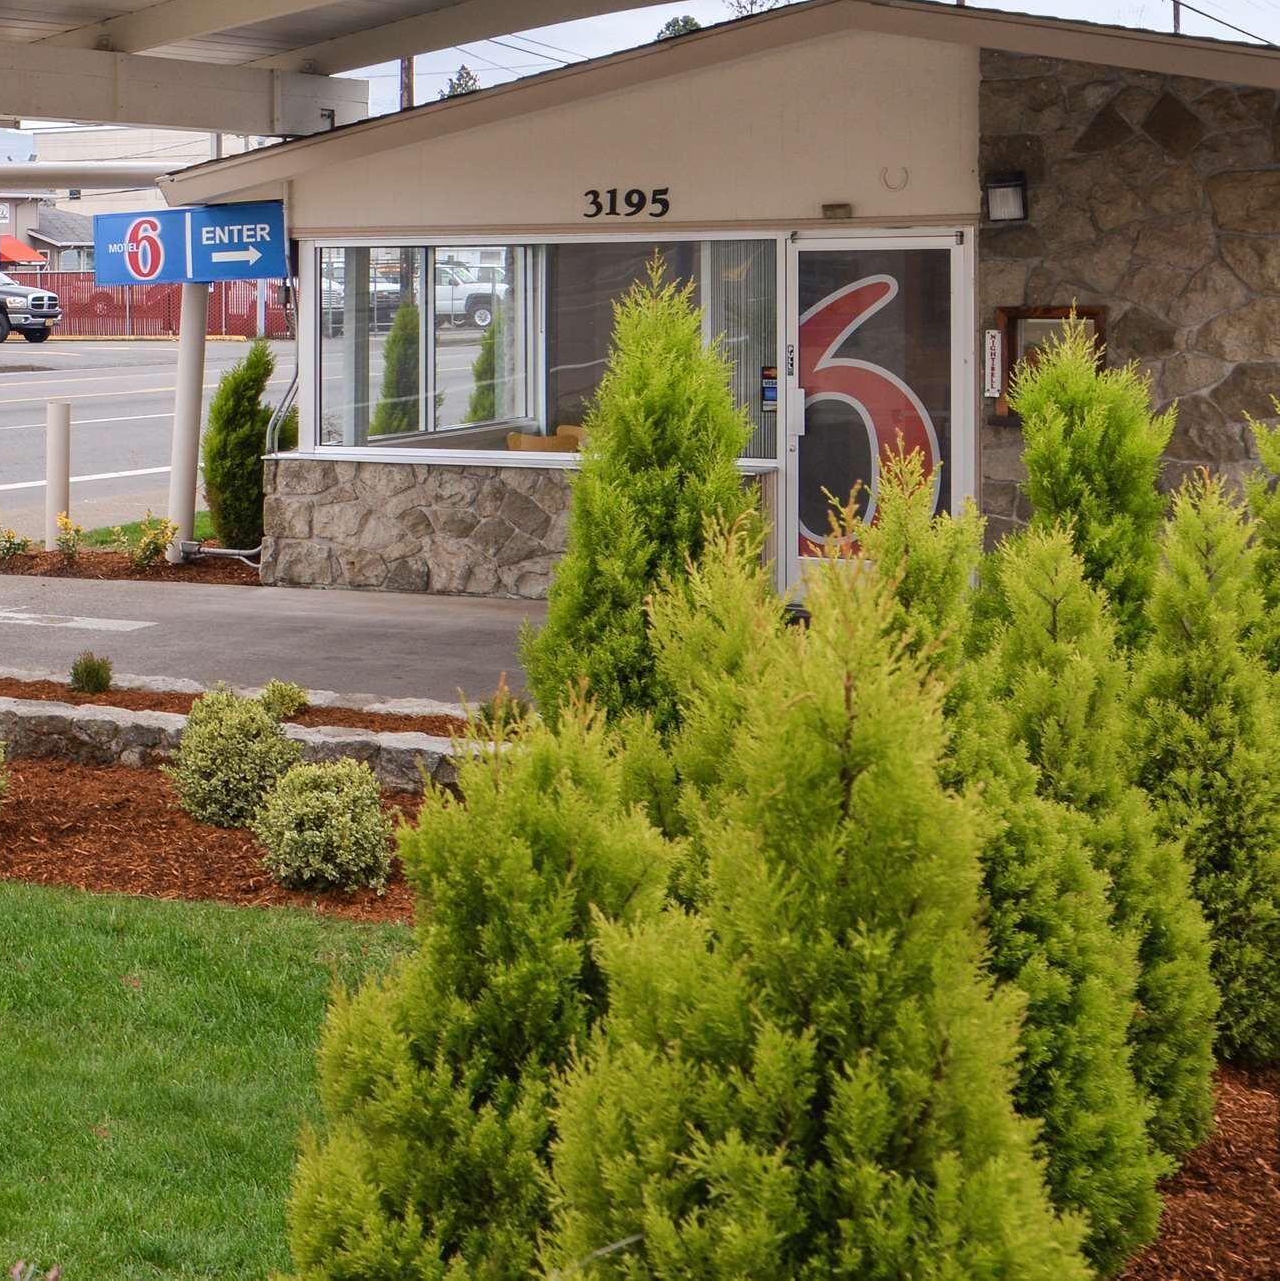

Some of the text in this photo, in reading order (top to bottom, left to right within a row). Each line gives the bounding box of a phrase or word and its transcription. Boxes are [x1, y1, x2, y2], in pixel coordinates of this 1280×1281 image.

[583, 187, 670, 218] 3195
[108, 218, 163, 279] MOTEL 6
[201, 223, 271, 245] ENTER
